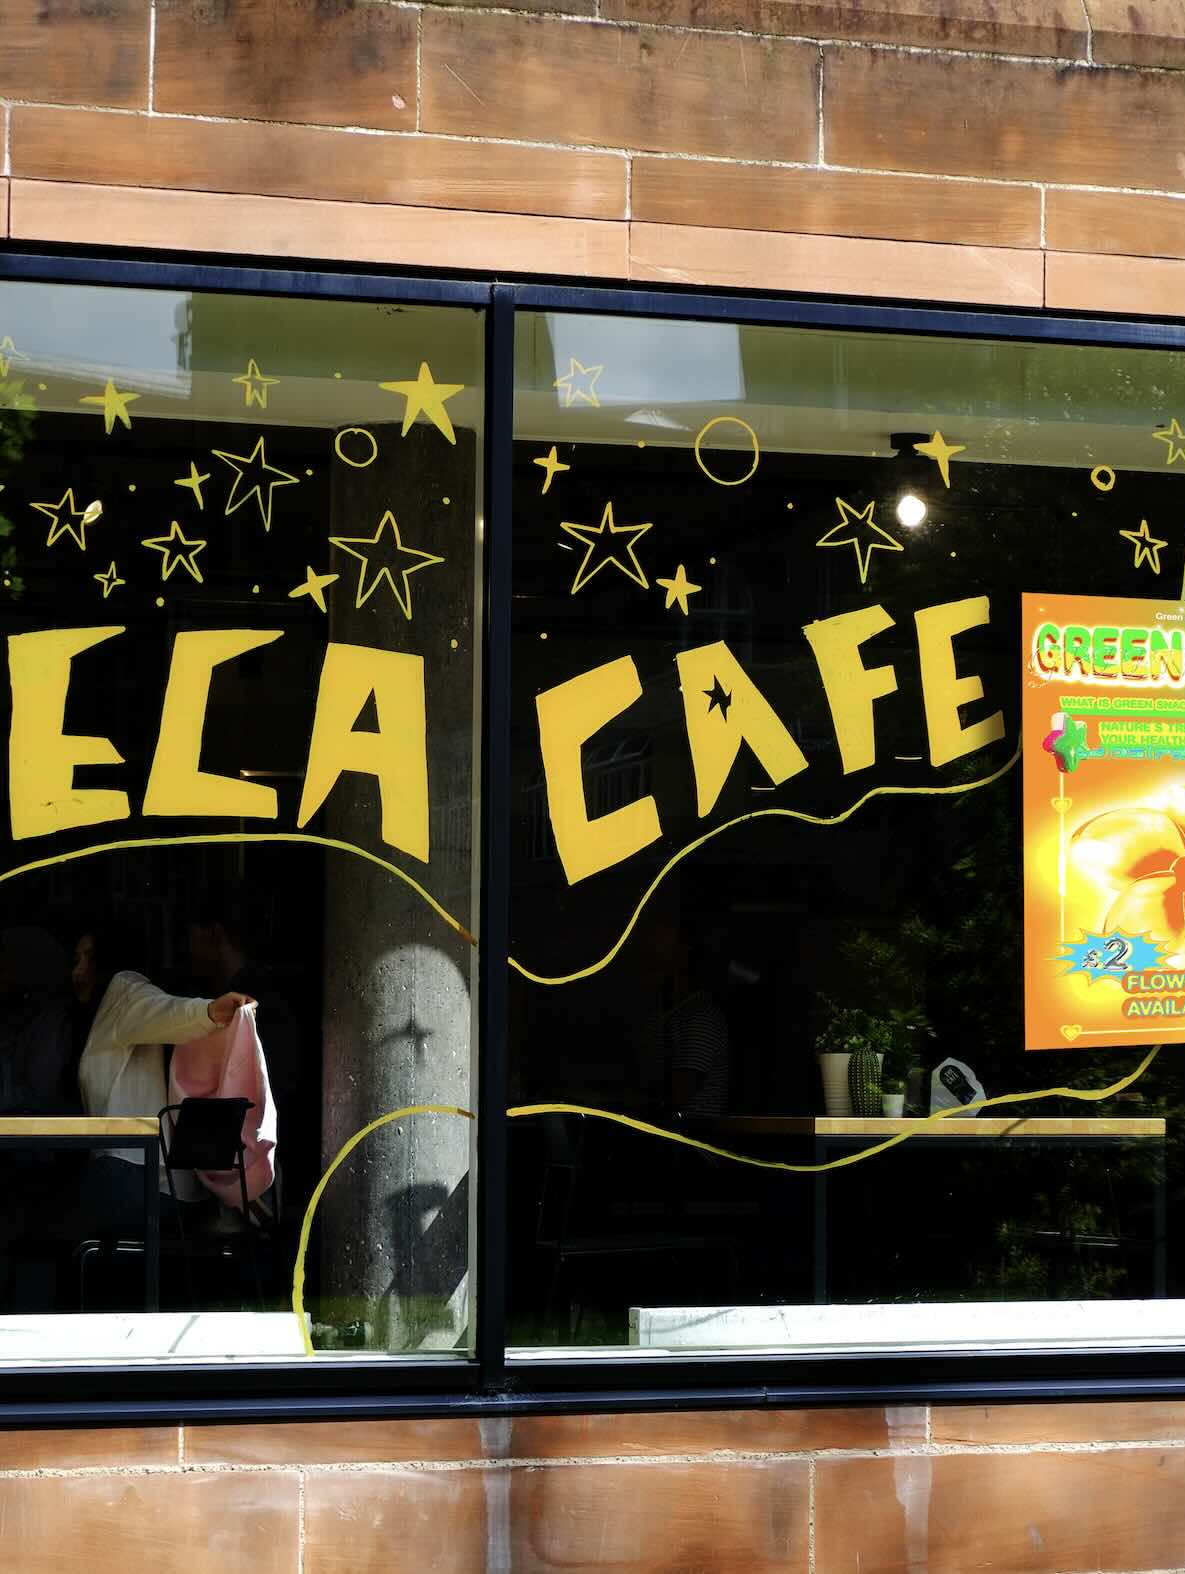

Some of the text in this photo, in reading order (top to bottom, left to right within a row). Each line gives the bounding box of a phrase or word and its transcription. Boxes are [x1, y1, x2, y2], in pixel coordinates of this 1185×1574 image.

[1061, 697, 1094, 708] WHAT
[1099, 698, 1110, 708] IS
[1115, 699, 1152, 709] GREEN
[8, 596, 1005, 885] ECA CAFE
[1101, 735, 1137, 745] YOUR
